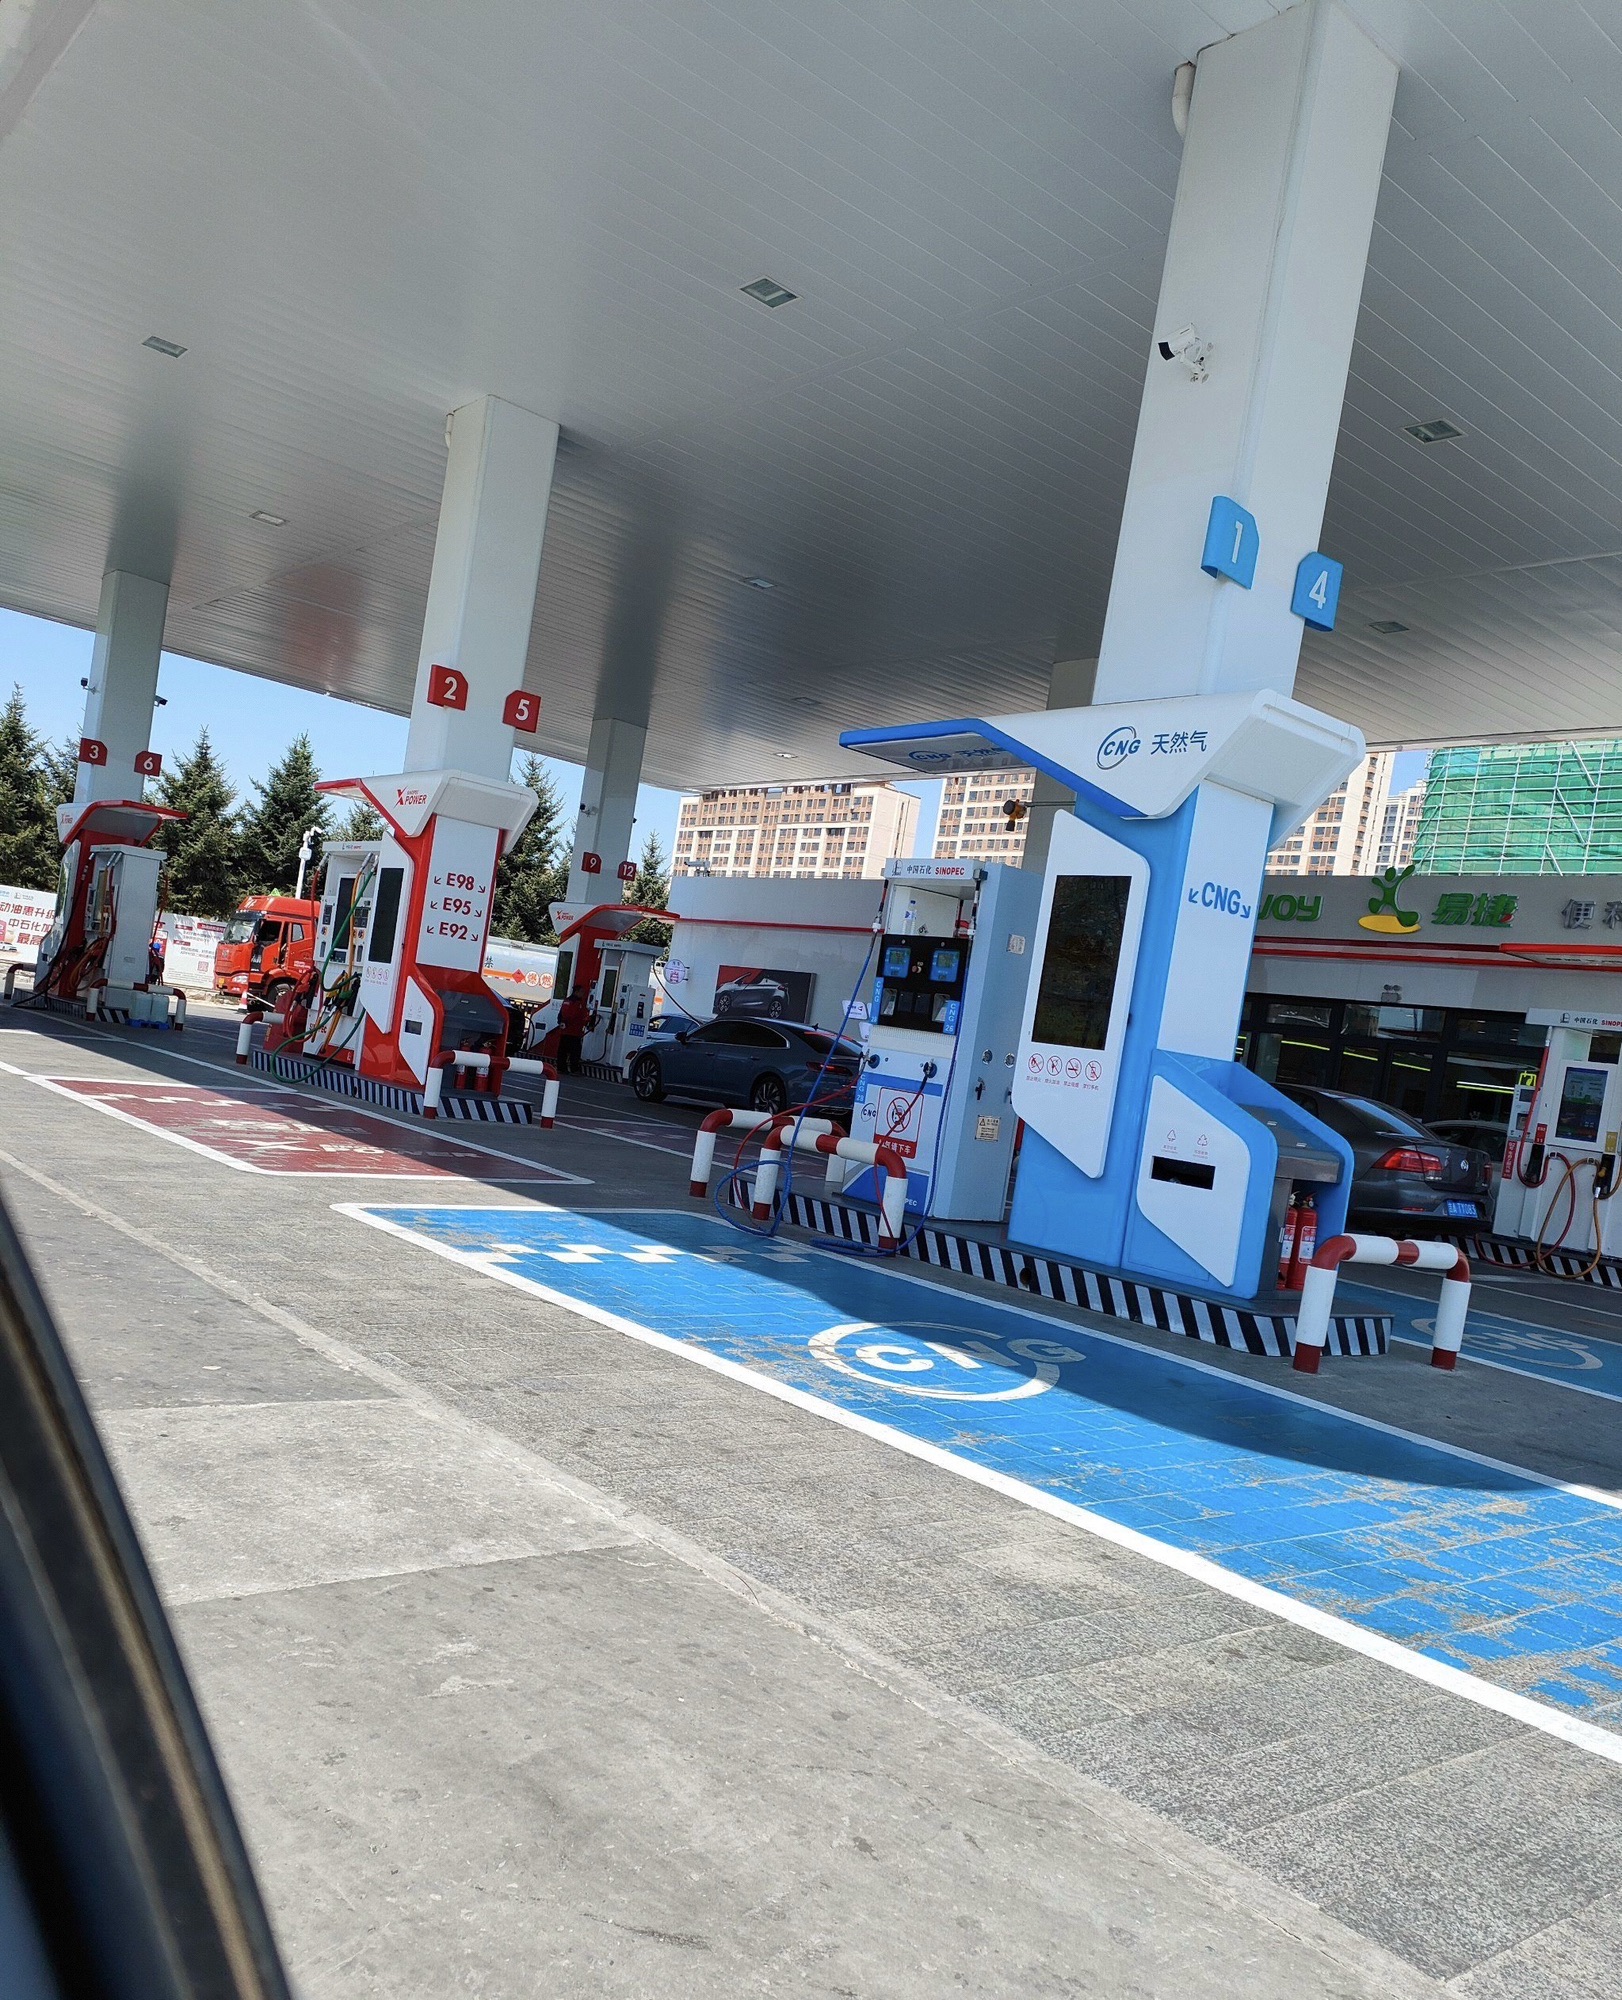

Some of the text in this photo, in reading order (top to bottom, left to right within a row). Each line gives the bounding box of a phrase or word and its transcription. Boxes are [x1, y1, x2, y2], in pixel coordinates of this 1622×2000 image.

[1231, 520, 1243, 564] 1
[1308, 570, 1328, 609] 4
[443, 676, 458, 700] 2
[515, 698, 530, 721] 5
[88, 744, 99, 759] 3
[1151, 730, 1208, 755] 天然气
[143, 756, 154, 770] 6
[589, 857, 597, 868] 9
[623, 864, 634, 878] 12
[907, 864, 965, 876] 中国石化 SINOPEC
[446, 872, 475, 891] E98
[442, 897, 472, 915] E95
[1202, 881, 1241, 915] CNG
[1430, 892, 1520, 928] 易捷
[439, 921, 468, 940] E92
[948, 1003, 956, 1022] CNG
[1574, 1016, 1598, 1025] 中国石化
[858, 1074, 866, 1093] CNG
[862, 1109, 877, 1118] CNG
[855, 1338, 1087, 1372] CNG
